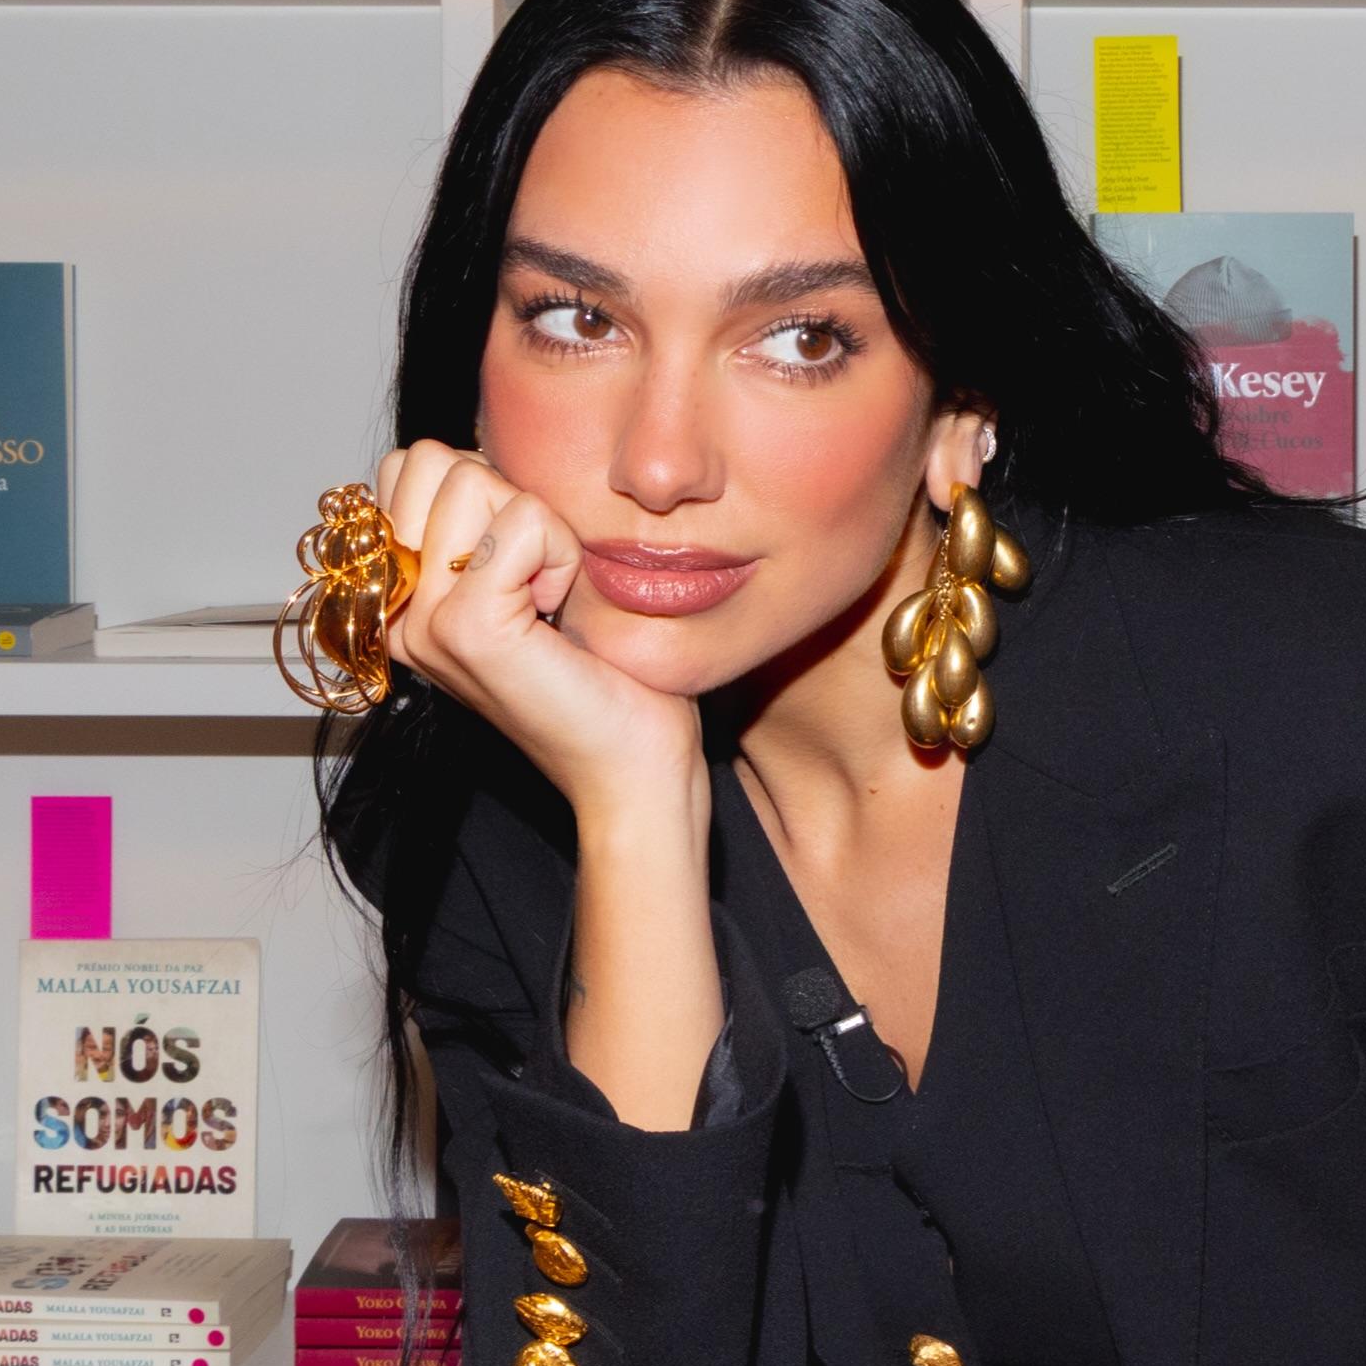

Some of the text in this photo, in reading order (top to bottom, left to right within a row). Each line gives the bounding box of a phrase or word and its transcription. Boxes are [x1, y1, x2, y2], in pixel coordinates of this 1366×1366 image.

[1210, 361, 1327, 408] Kesey
[36, 976, 241, 995] MALALA YOUSAFZAI
[123, 962, 159, 973] NOBEL
[165, 963, 181, 973] DA
[185, 963, 205, 973] PAZ
[74, 1013, 201, 1084] NÓS
[32, 1095, 239, 1152] SOMOS
[33, 1164, 237, 1195] REFUGIADAS
